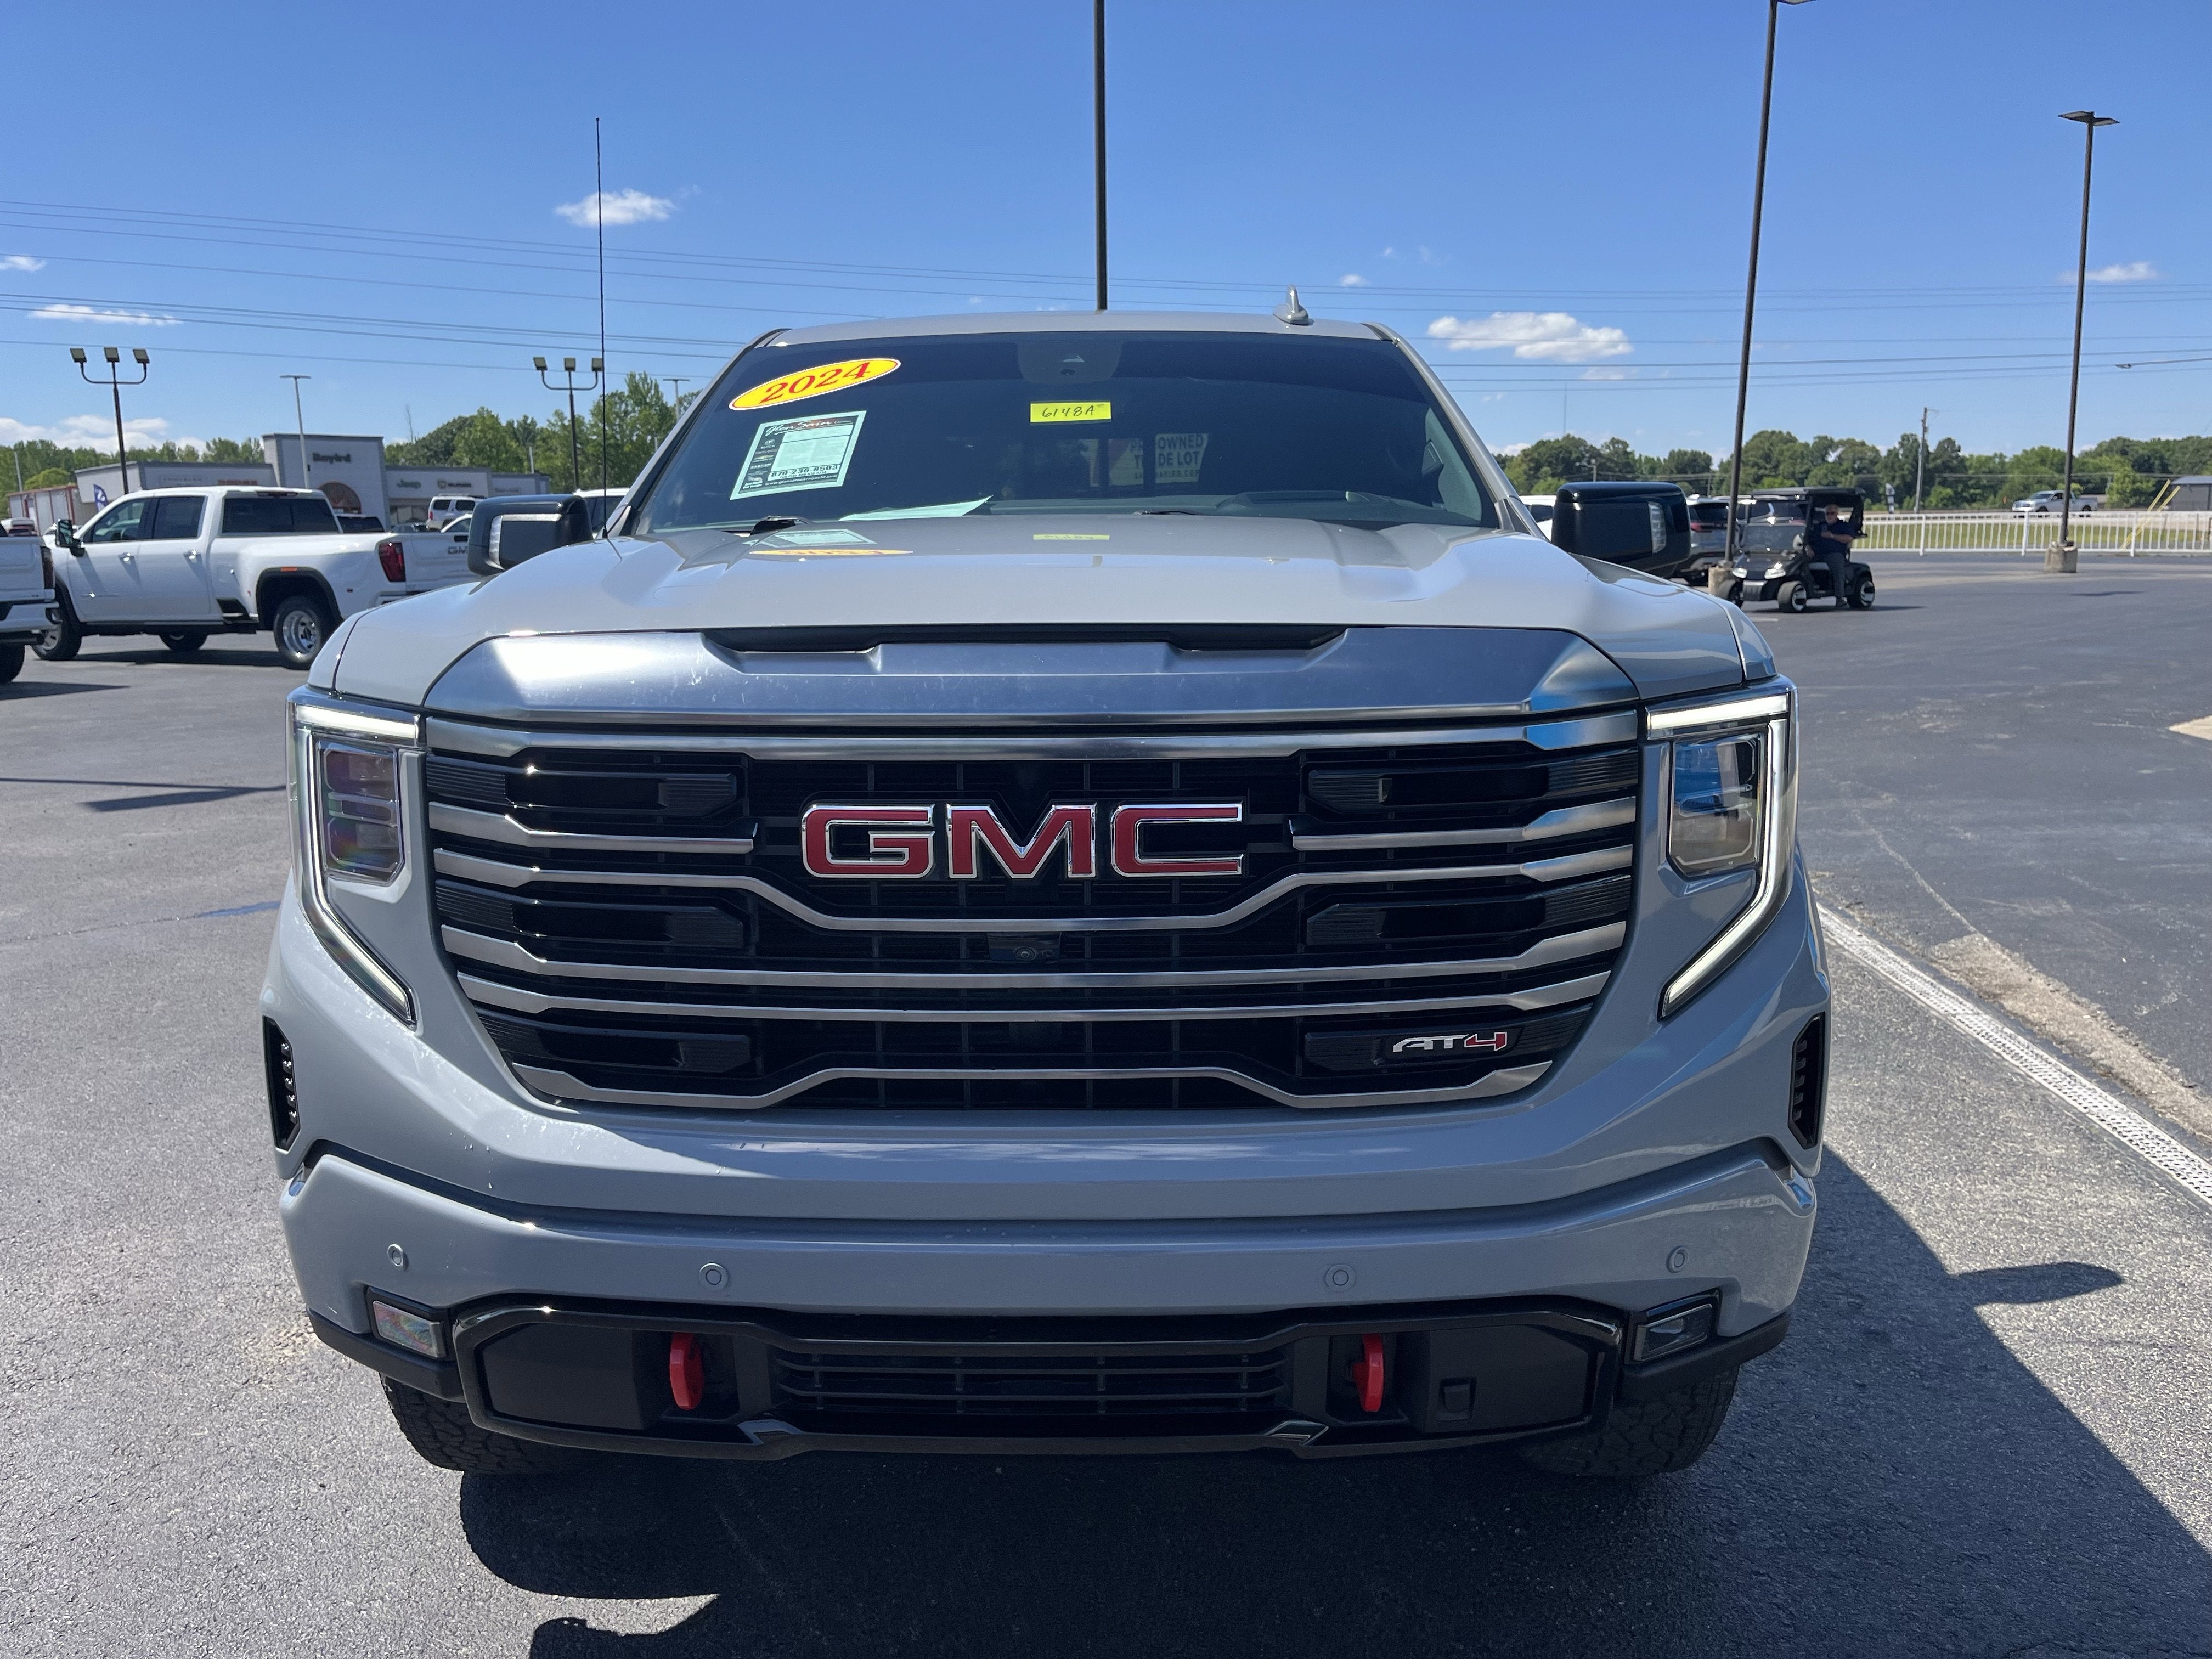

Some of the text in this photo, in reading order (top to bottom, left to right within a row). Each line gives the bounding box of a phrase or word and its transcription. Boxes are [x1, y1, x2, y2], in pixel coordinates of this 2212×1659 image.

[759, 362, 871, 404] 2024
[1042, 405, 1094, 417] 6148A
[1158, 435, 1204, 450] OWNED
[1177, 451, 1200, 465] LOT
[771, 465, 838, 477] 870-236-8503
[802, 804, 1244, 878] GMC
[1392, 1031, 1508, 1052] AT4
